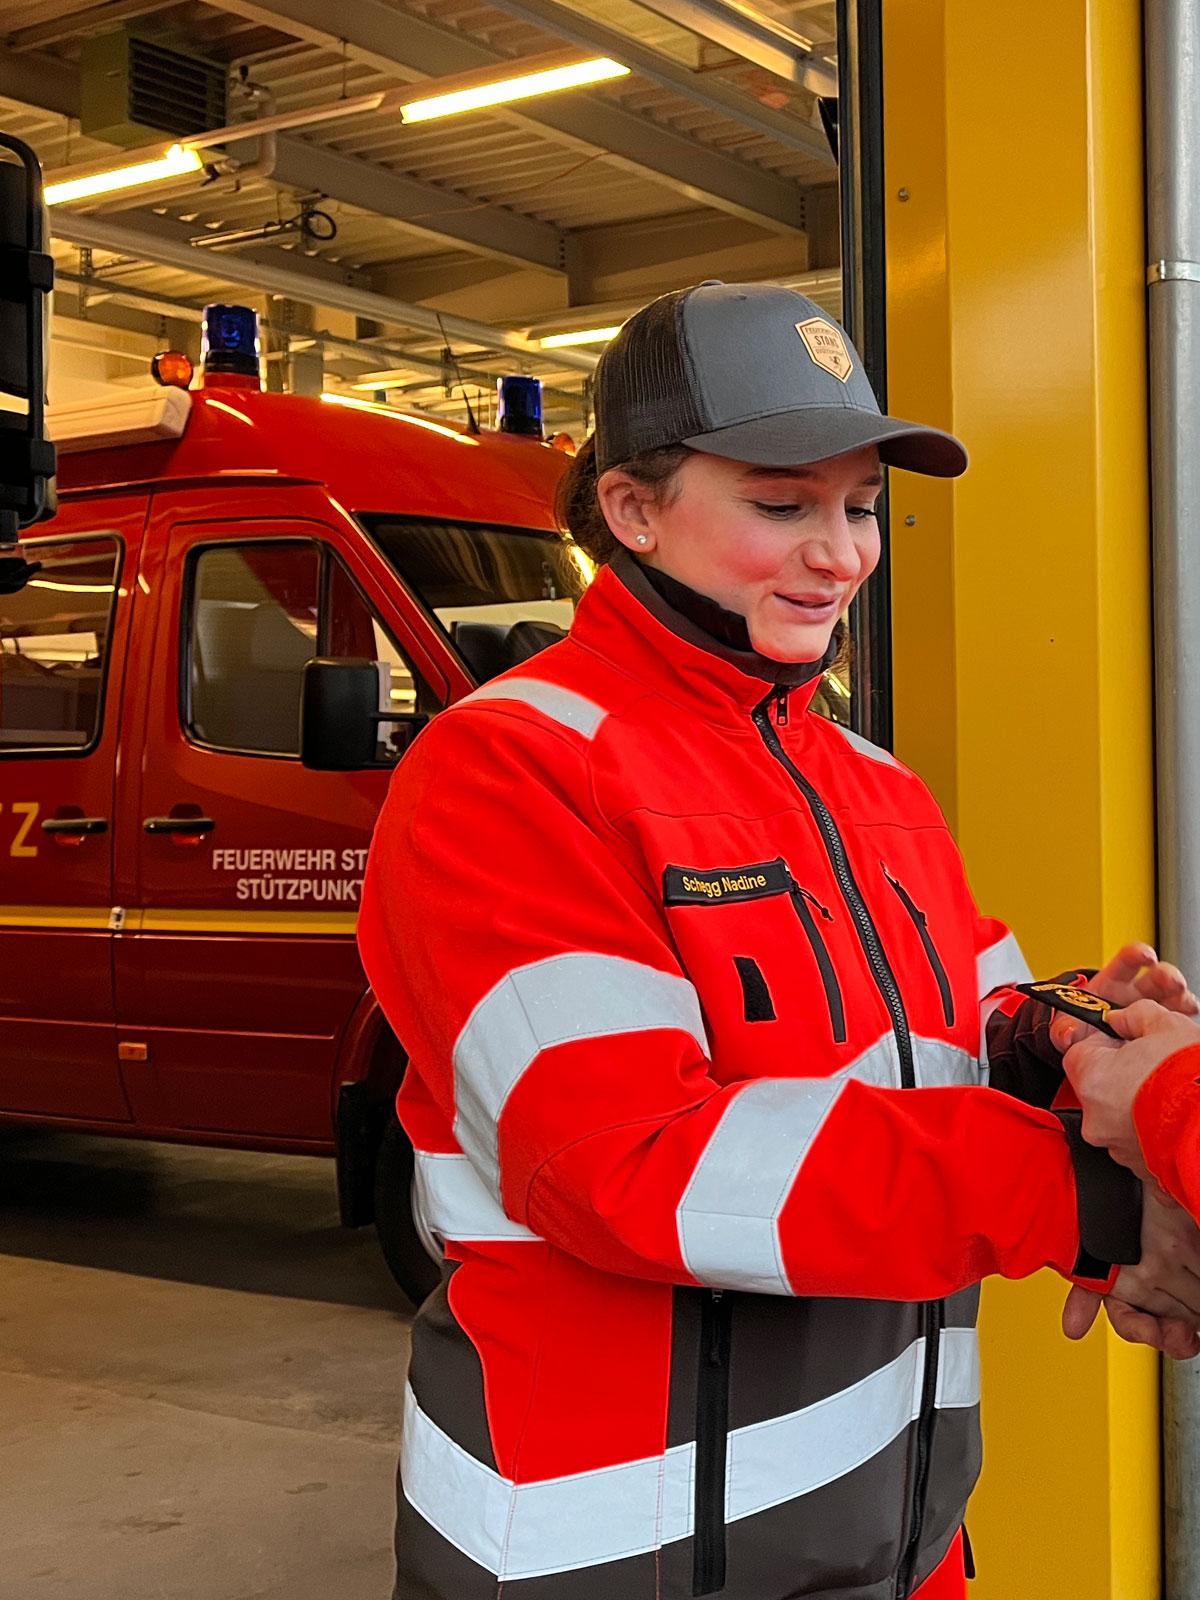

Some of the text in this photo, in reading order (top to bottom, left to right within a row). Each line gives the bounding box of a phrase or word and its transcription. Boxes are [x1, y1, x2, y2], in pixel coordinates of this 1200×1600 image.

[0, 802, 39, 857] Z
[212, 849, 337, 871] FEUERWEHR
[682, 875, 767, 897] Schegg Nadine
